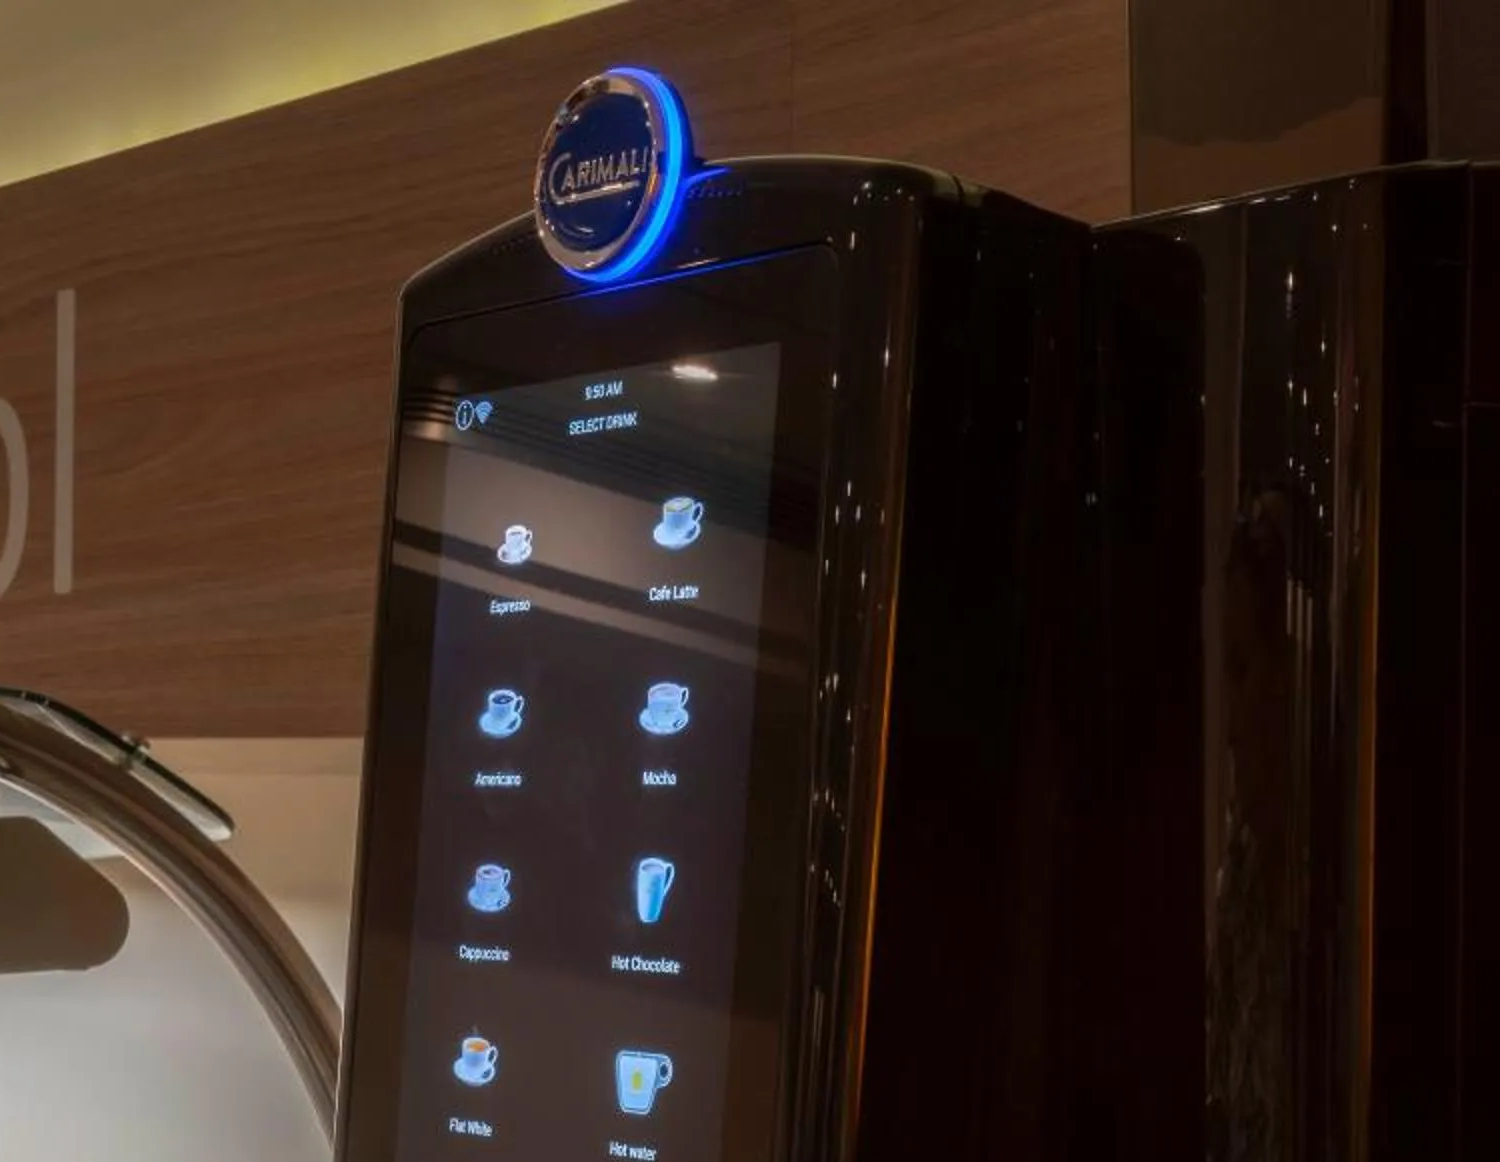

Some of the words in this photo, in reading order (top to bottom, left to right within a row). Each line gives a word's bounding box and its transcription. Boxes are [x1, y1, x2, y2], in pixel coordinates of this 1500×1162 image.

[550, 147, 648, 204] CARIMALI
[606, 380, 623, 397] AM
[569, 416, 605, 436] SELECT
[605, 411, 638, 430] DRINK
[673, 585, 699, 600] Latte
[490, 599, 531, 616] Espresso
[475, 772, 522, 787] Americano
[642, 771, 677, 786] Mocha
[459, 945, 510, 962] Cappuccino
[611, 955, 630, 970] Hot
[631, 957, 681, 974] Chocolate
[449, 1117, 467, 1133] Flat
[467, 1121, 493, 1138] White
[609, 1141, 627, 1157] Hot
[629, 1146, 657, 1162] water
